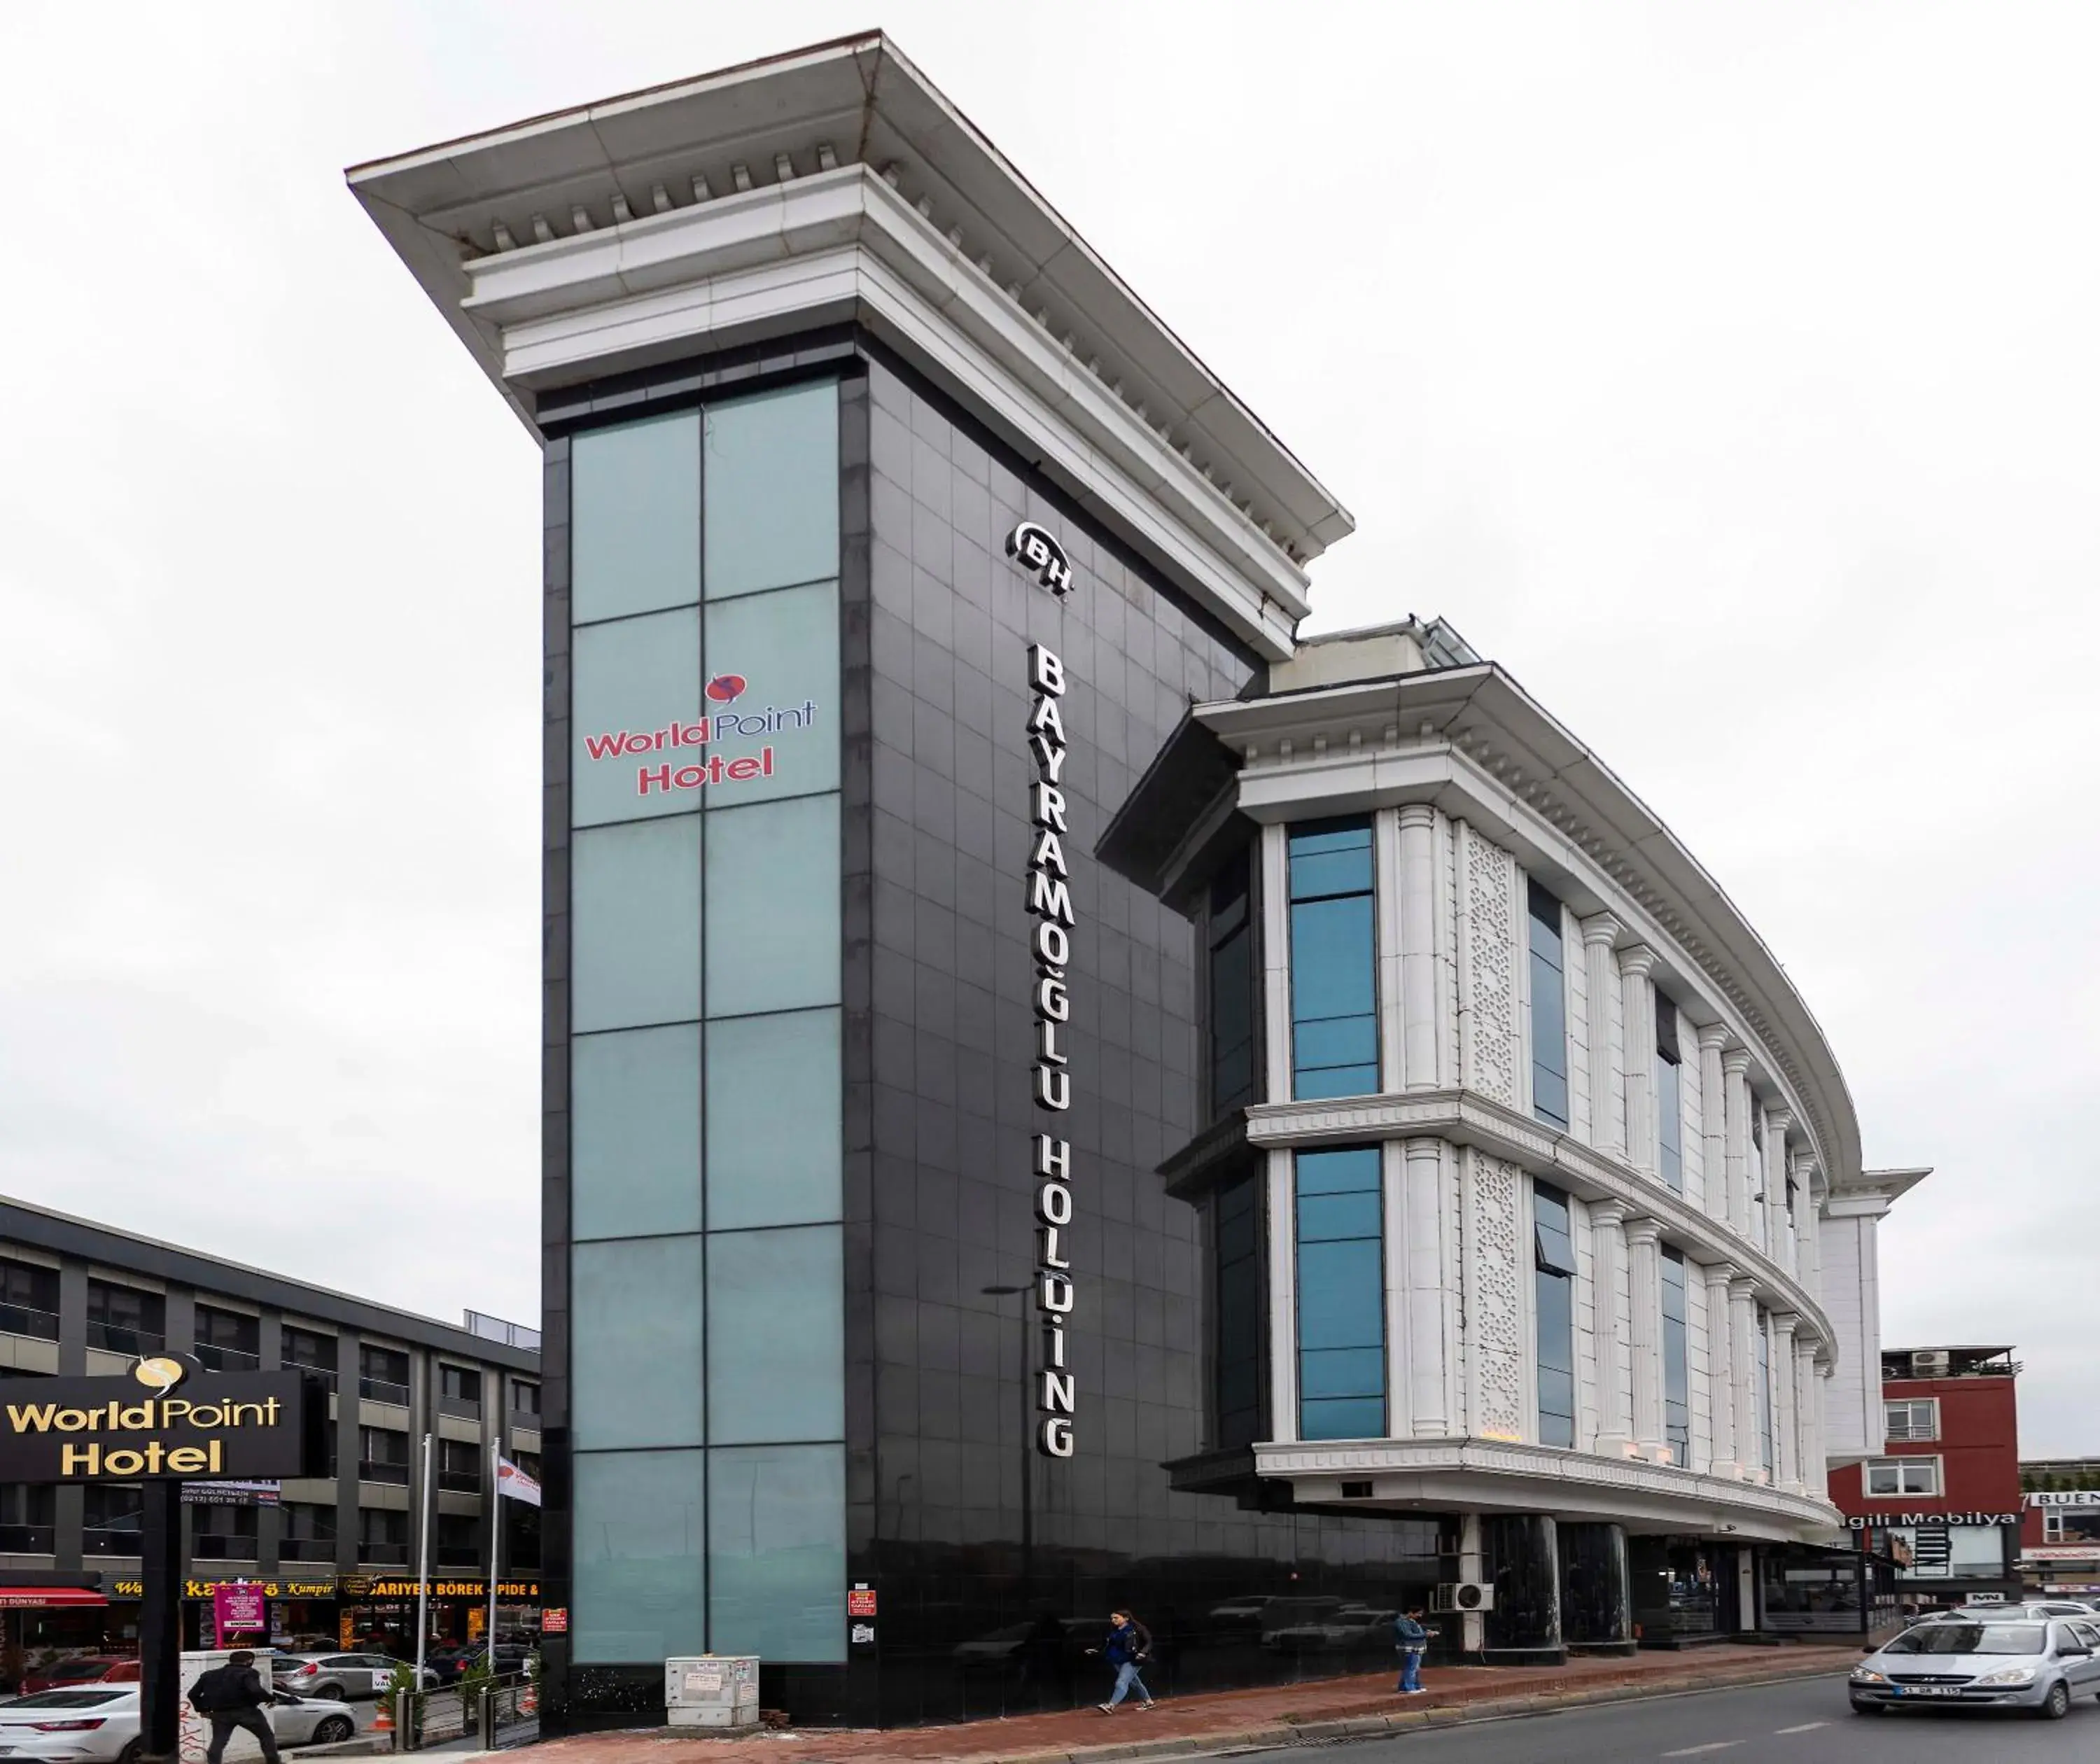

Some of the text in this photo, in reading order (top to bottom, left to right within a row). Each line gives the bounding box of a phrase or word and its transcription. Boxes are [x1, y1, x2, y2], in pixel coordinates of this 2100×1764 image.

[1022, 534, 1072, 592] BH
[638, 746, 774, 796] Hotel
[62, 1440, 222, 1476] Hotel
[2038, 1492, 2100, 1504] BUEN
[1900, 1511, 2017, 1527] Mobilya
[114, 1581, 144, 1597] Wa
[287, 1582, 335, 1597] Kumpir
[436, 1580, 484, 1596] BÖREK
[497, 1581, 526, 1596] PİDE
[530, 1583, 538, 1596] &
